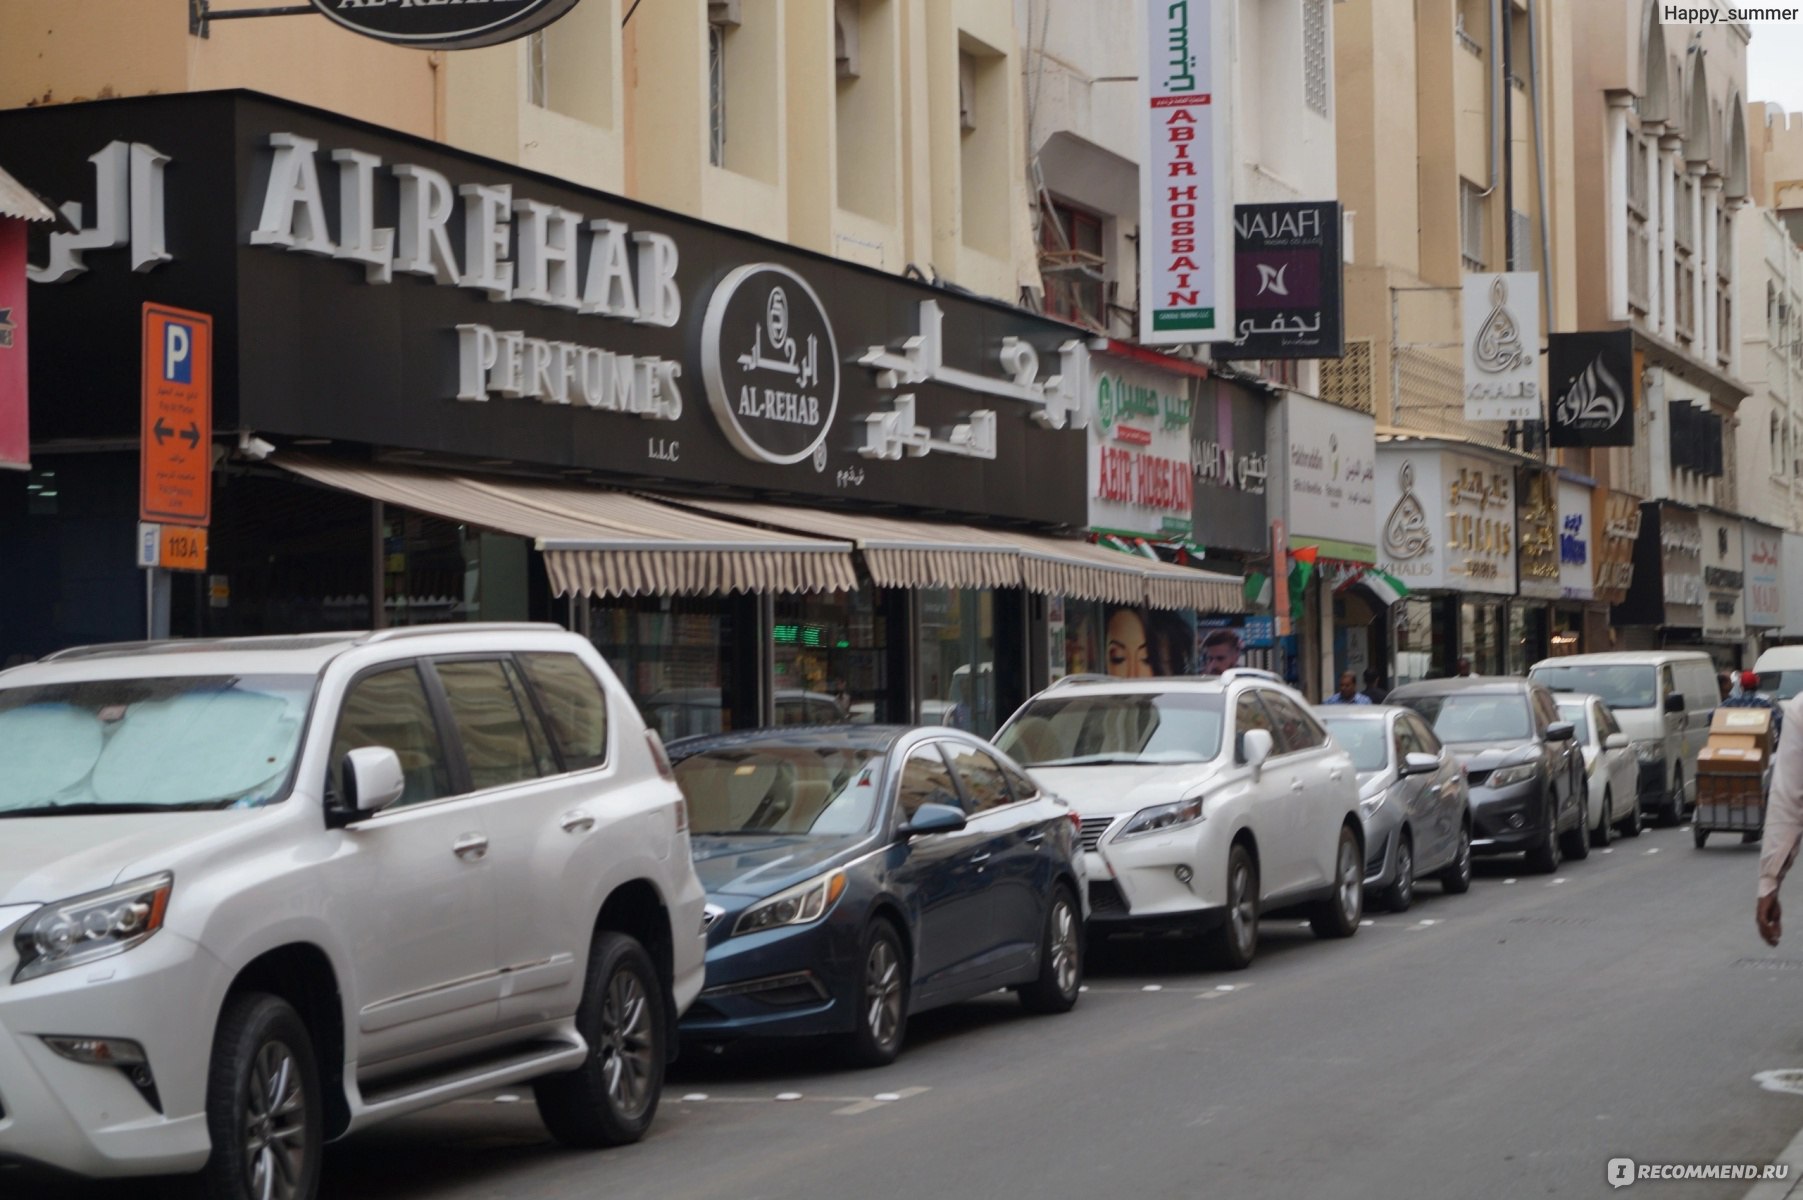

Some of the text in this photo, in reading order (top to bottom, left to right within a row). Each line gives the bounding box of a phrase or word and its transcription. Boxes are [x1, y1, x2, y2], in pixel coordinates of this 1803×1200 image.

[1166, 108, 1197, 177] ABIR
[1165, 184, 1200, 308] HOSSAIN
[1234, 208, 1321, 240] NAJAFI
[166, 324, 189, 379] P
[456, 323, 683, 421] PERFUMES
[738, 384, 820, 425] AL-REHAB
